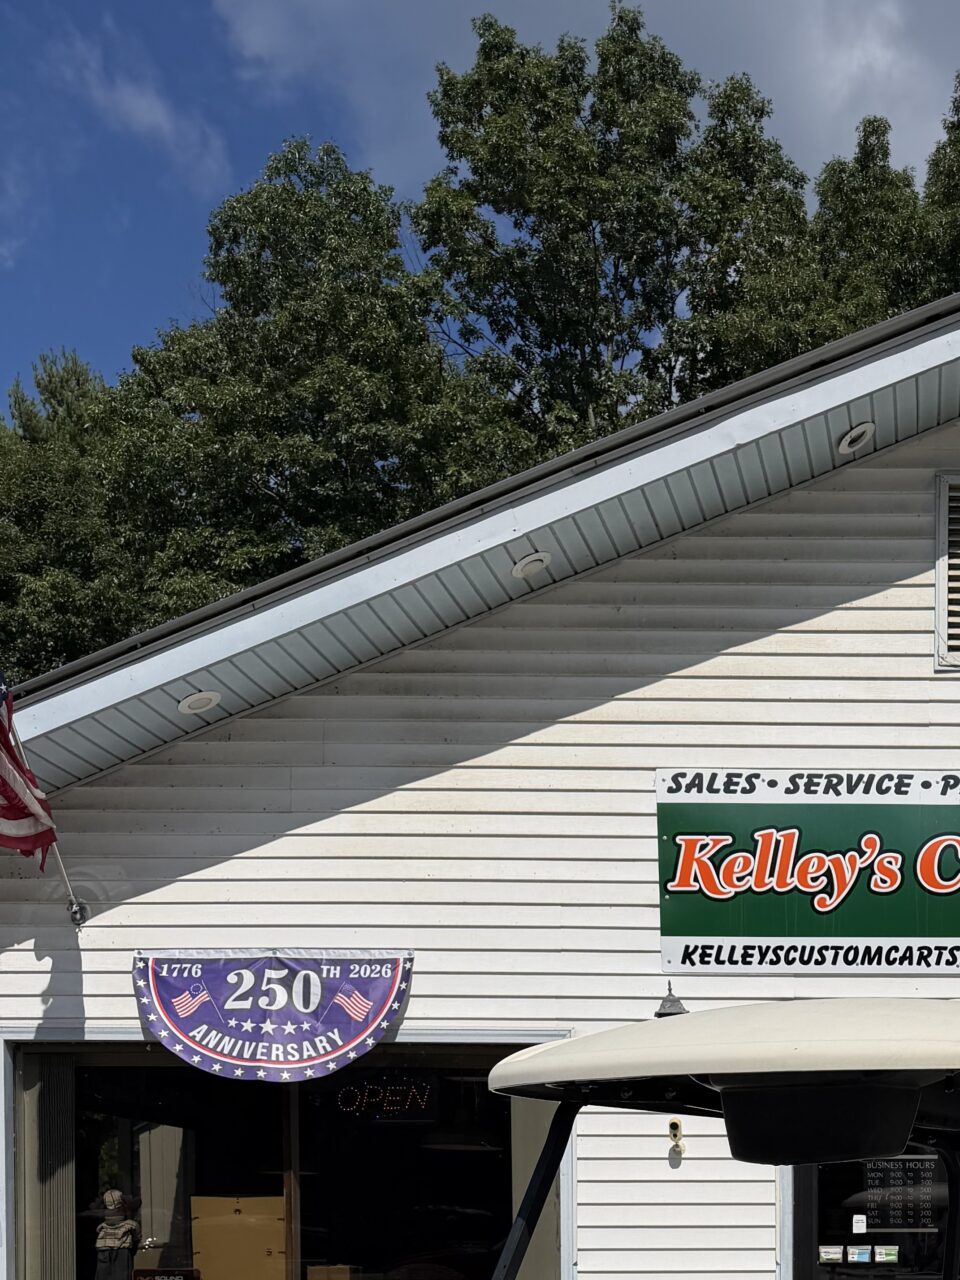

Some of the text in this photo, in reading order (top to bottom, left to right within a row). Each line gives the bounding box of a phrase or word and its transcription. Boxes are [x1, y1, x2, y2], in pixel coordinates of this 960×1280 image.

[666, 772, 760, 794] SALES
[784, 773, 914, 797] SERVICE
[667, 828, 902, 912] Kelley's
[158, 963, 202, 978] 1776
[349, 963, 392, 978] 2026
[188, 1023, 344, 1062] ANNIVERSARY
[338, 1086, 430, 1110] OPEN
[866, 1161, 935, 1169] BUSINESS HOURS
